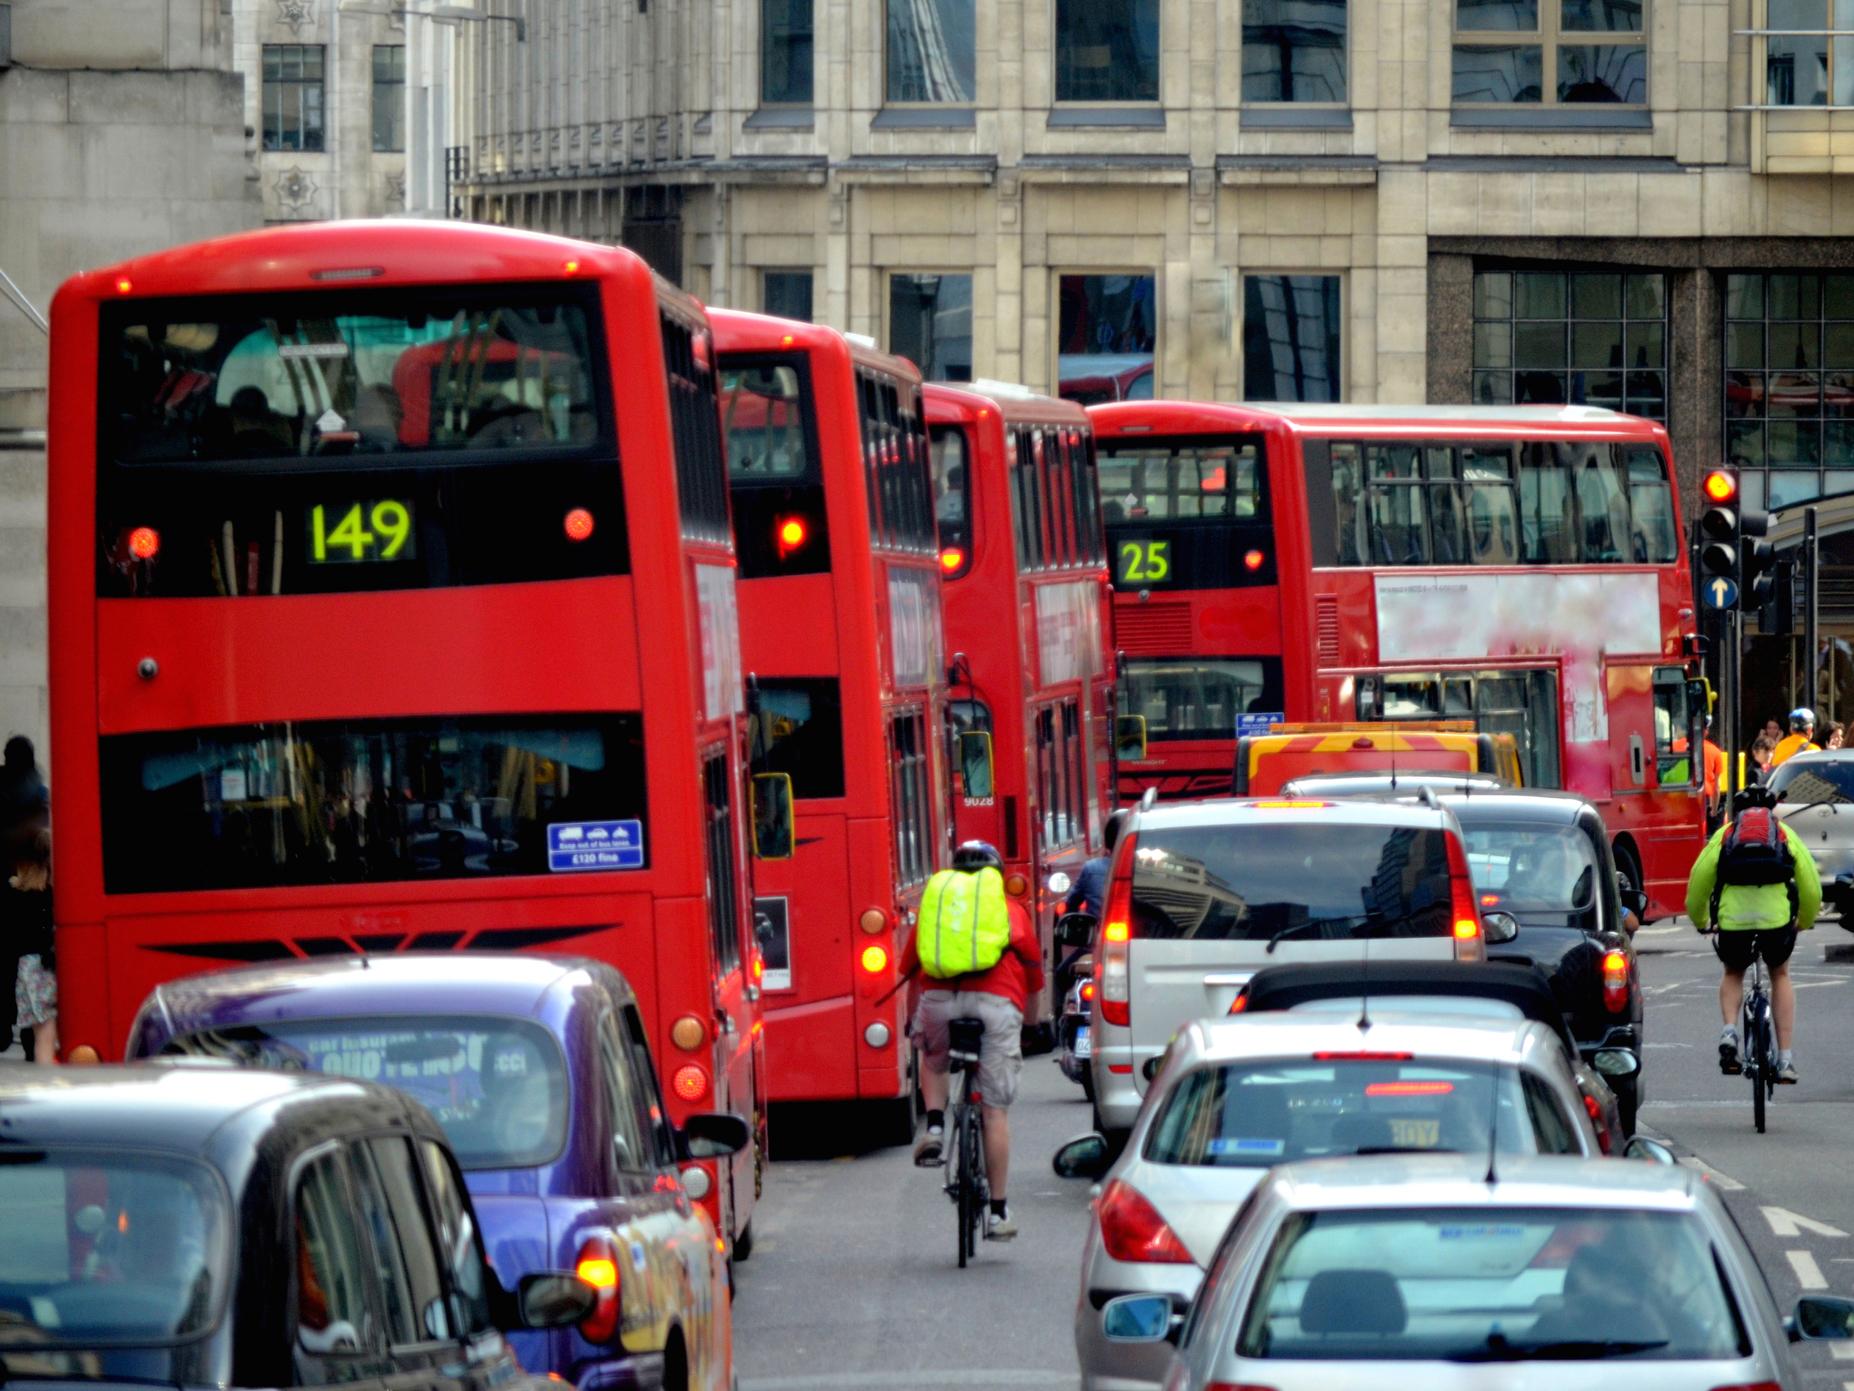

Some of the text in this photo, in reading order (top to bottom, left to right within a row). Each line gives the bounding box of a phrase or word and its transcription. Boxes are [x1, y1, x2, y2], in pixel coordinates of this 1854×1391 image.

[312, 500, 410, 560] 149
[1122, 542, 1168, 580] 25
[572, 852, 619, 865] £120 fine
